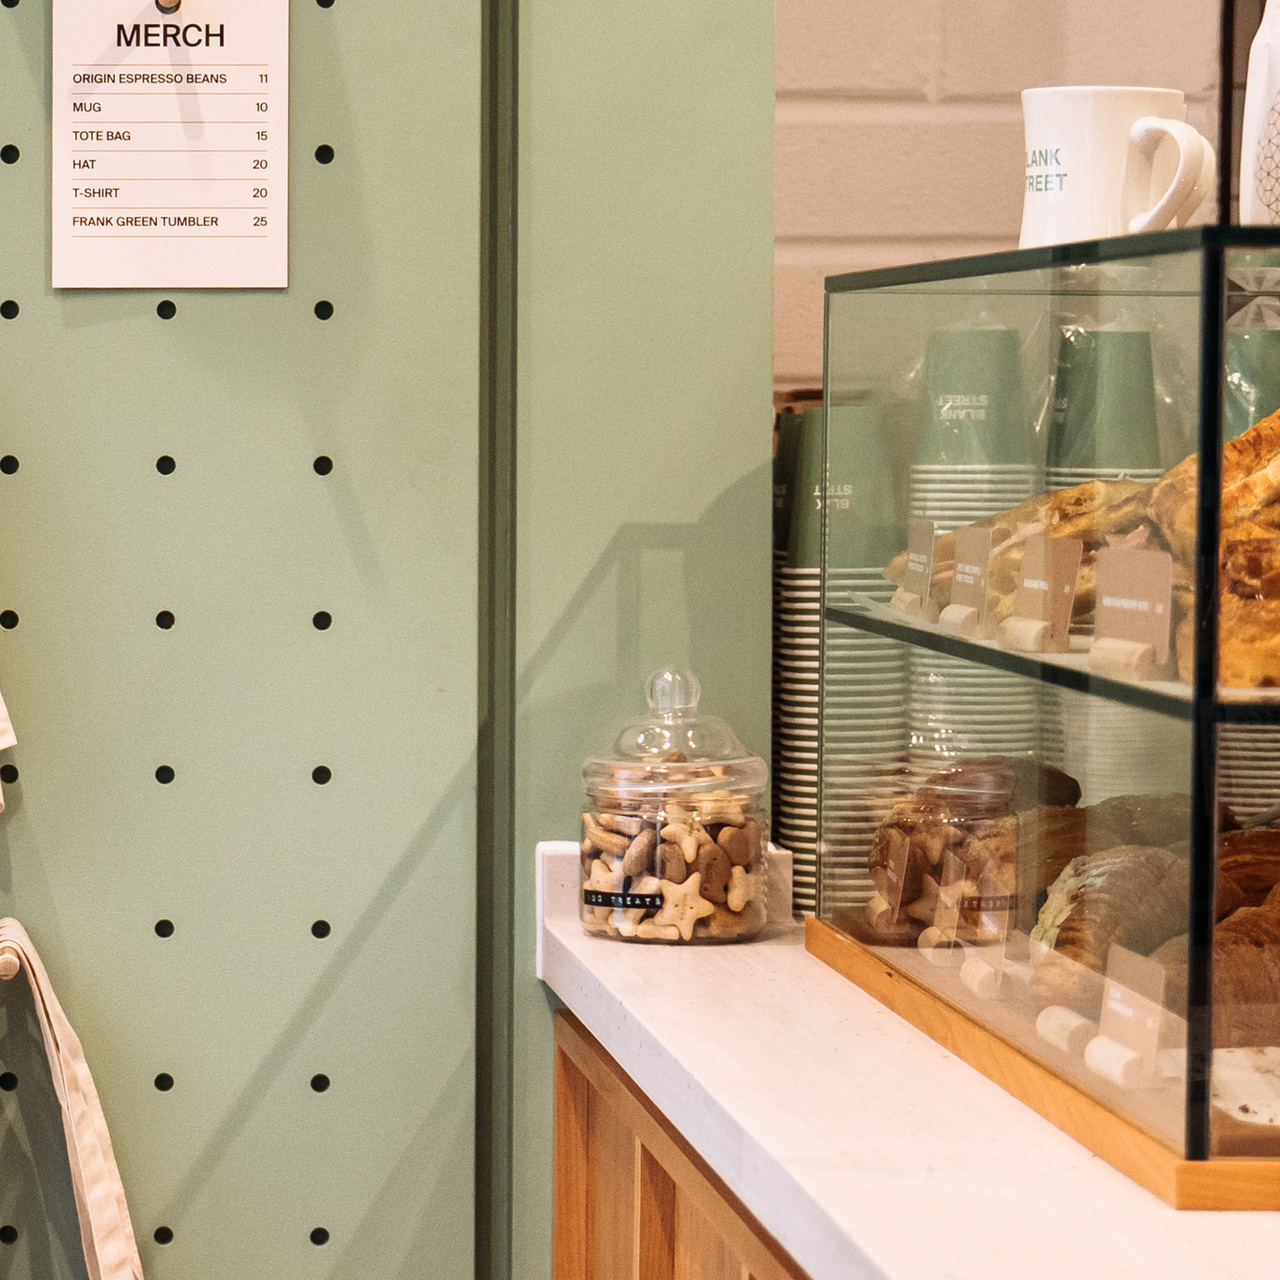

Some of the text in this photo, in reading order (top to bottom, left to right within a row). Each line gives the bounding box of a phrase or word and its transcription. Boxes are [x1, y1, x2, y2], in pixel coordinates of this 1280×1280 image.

[116, 23, 225, 48] MERCH
[72, 73, 268, 84] ORIGIN ESPRESSO BEANS 11
[72, 102, 268, 113] MUG 10
[72, 130, 268, 141] TOTE BAG 15
[1027, 149, 1061, 167] ANK
[72, 159, 268, 170] HAT 20
[1026, 173, 1067, 192] REET
[72, 187, 268, 198] T-SHIRT 20
[72, 216, 268, 227] FRANK GREEN TUMBLER 25
